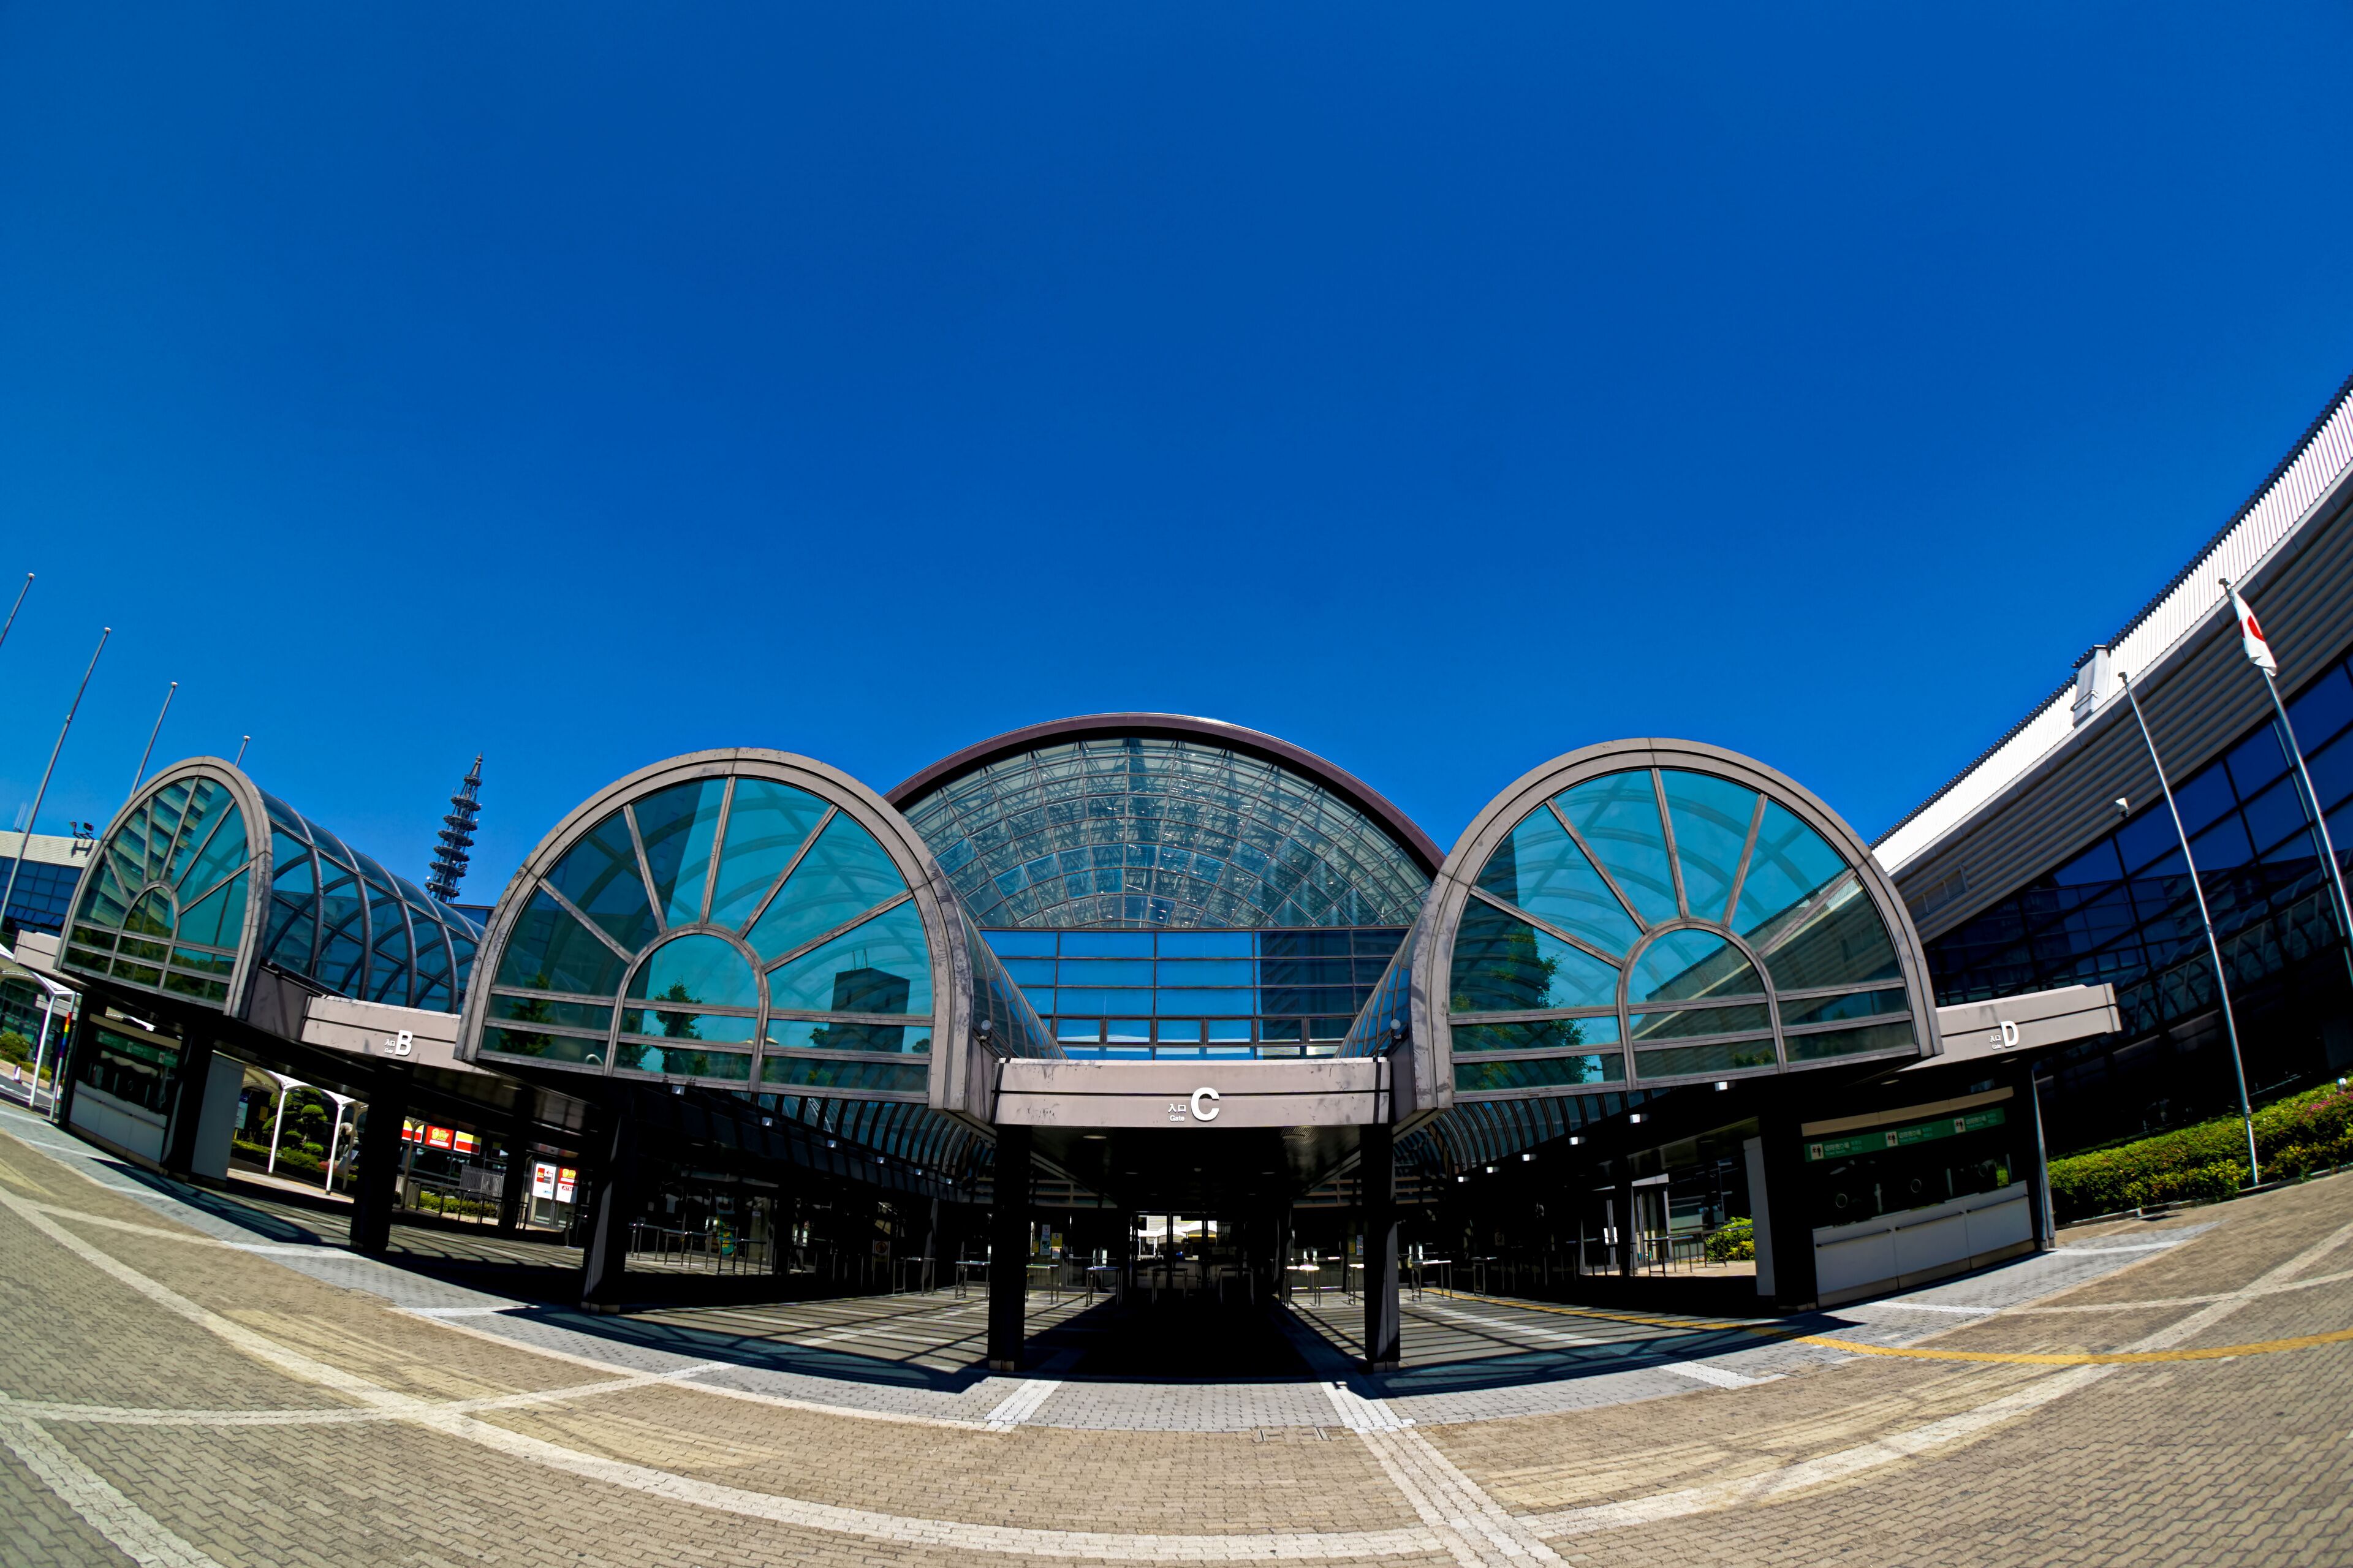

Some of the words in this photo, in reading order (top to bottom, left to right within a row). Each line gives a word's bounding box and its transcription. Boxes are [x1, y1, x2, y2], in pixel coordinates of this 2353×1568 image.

[395, 1030, 413, 1056] B
[2000, 1021, 2019, 1047] D
[1168, 1104, 1186, 1113] 入口
[1191, 1087, 1219, 1121] C
